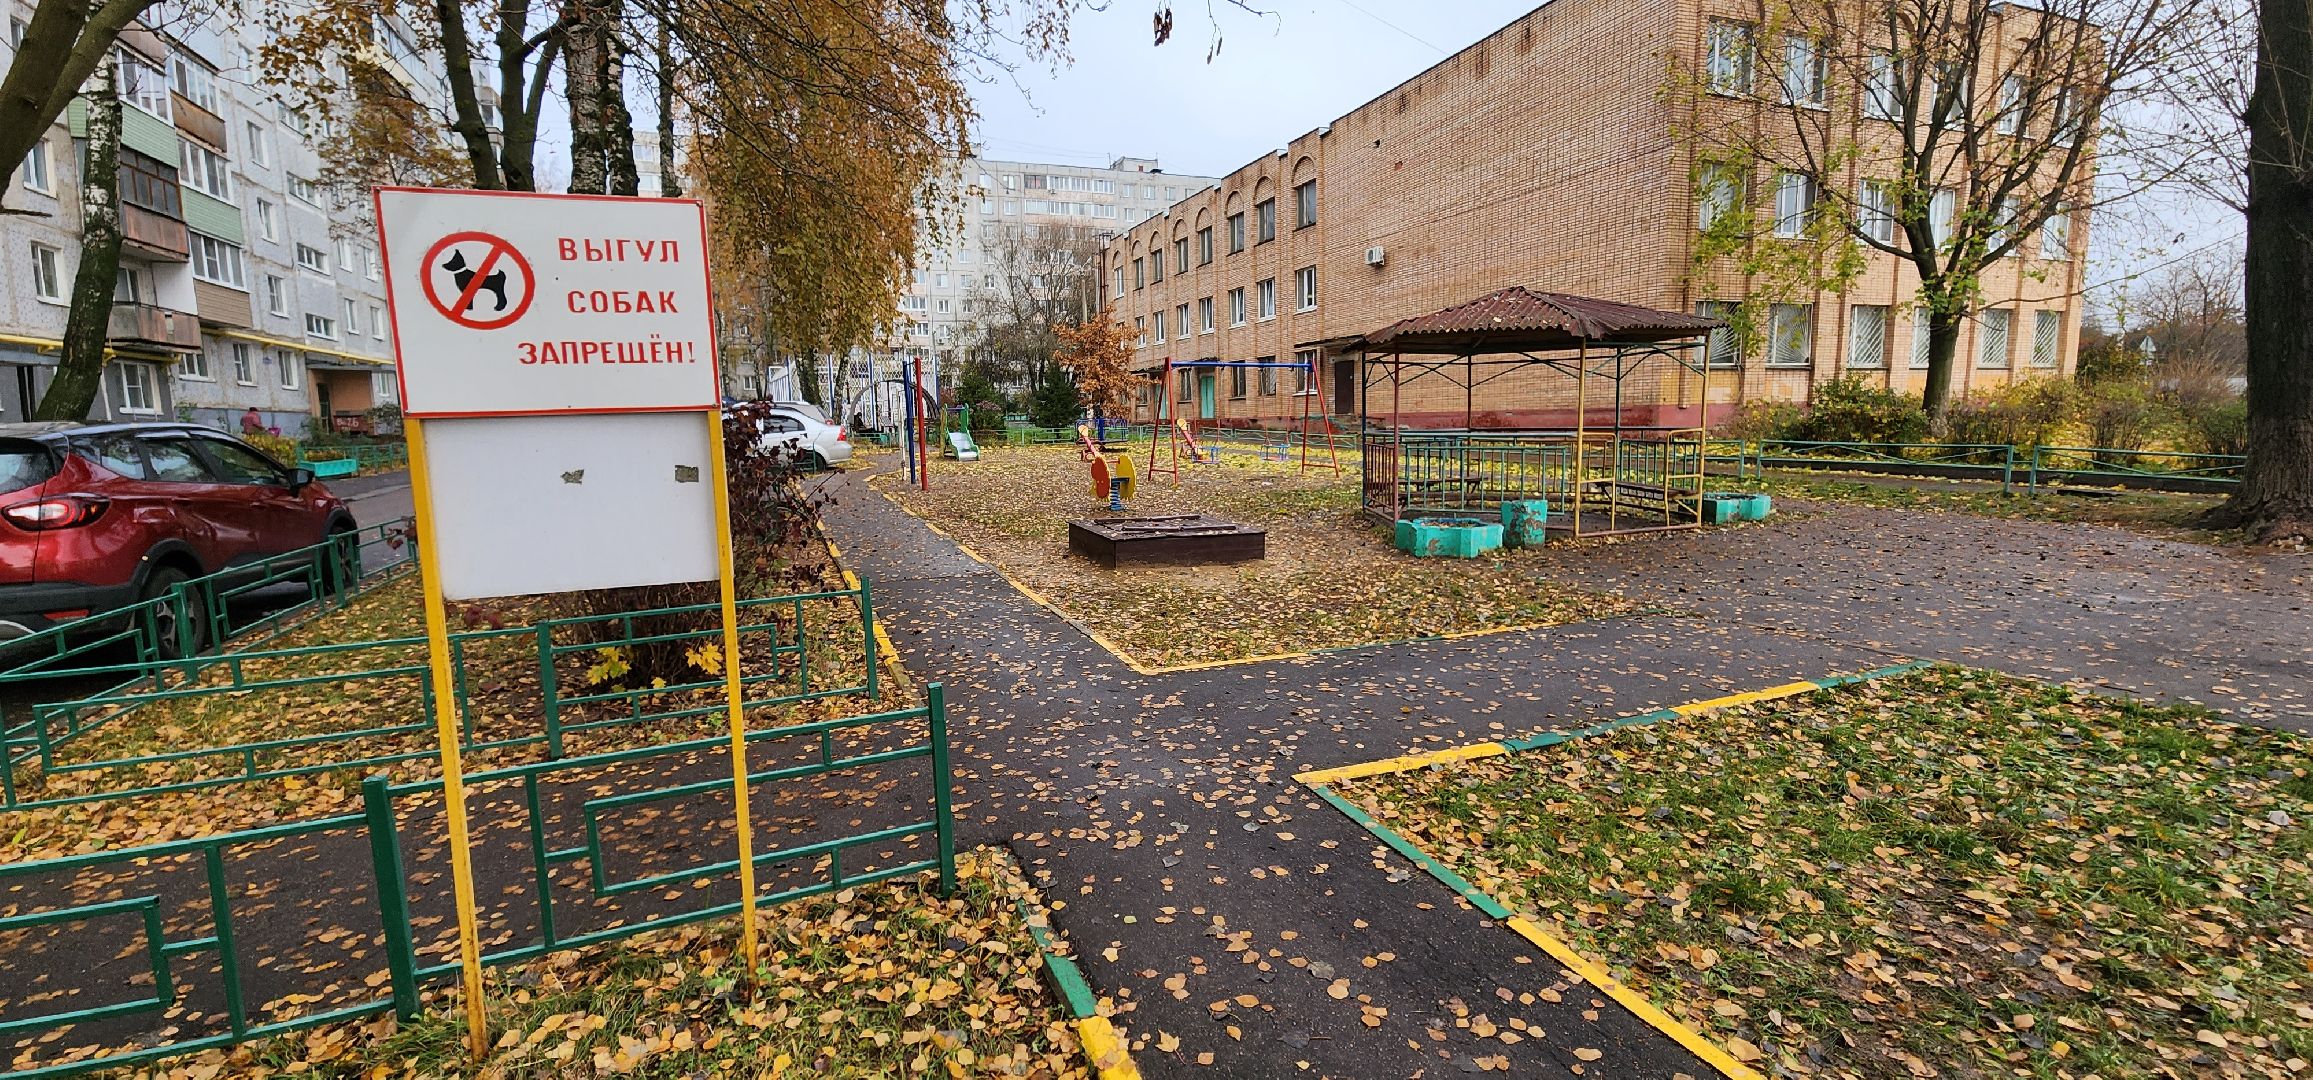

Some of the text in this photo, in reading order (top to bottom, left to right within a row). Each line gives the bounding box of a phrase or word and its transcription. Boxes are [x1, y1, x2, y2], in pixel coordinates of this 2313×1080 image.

[558, 237, 680, 263] ВЫГУЛ
[567, 290, 679, 314] СОБАК
[517, 333, 696, 365] ЗАПРЕЩЁН!
